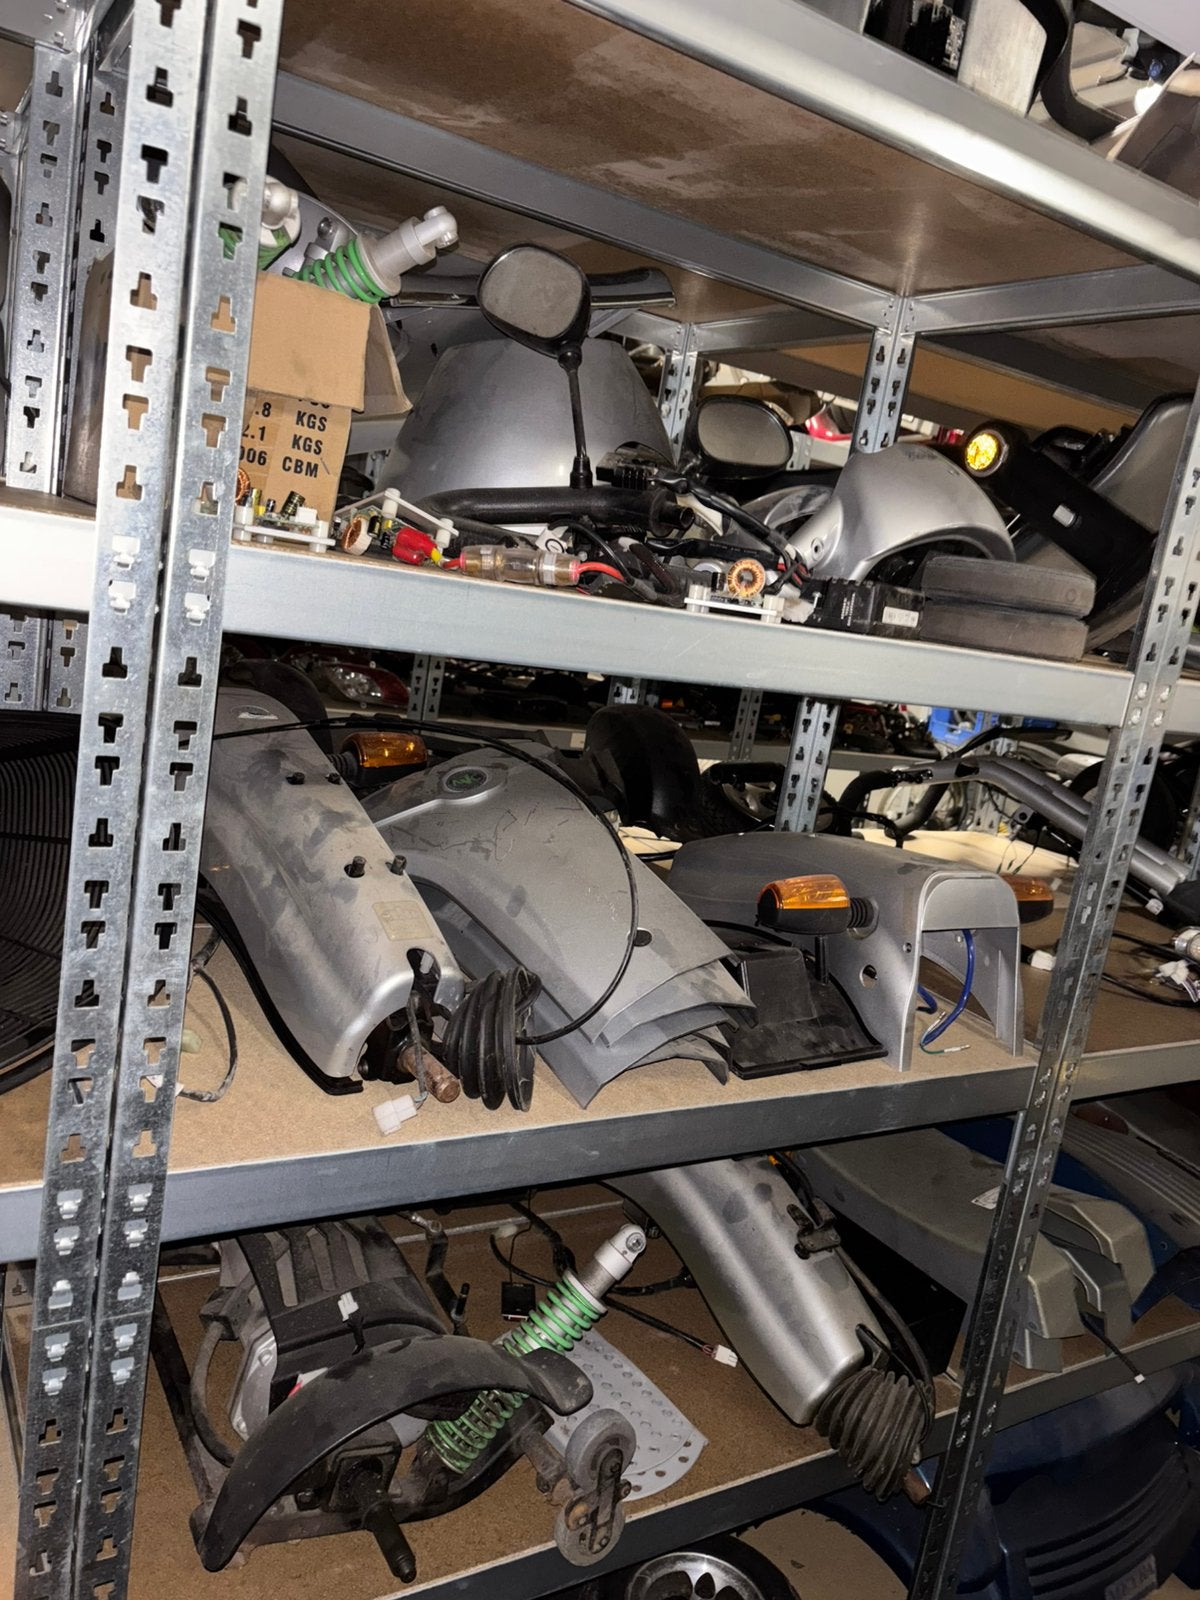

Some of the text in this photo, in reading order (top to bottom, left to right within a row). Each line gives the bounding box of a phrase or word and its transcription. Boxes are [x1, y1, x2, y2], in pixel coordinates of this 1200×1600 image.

[295, 410, 328, 432] KGS
[291, 433, 323, 456] KGS
[282, 456, 319, 478] CBM
